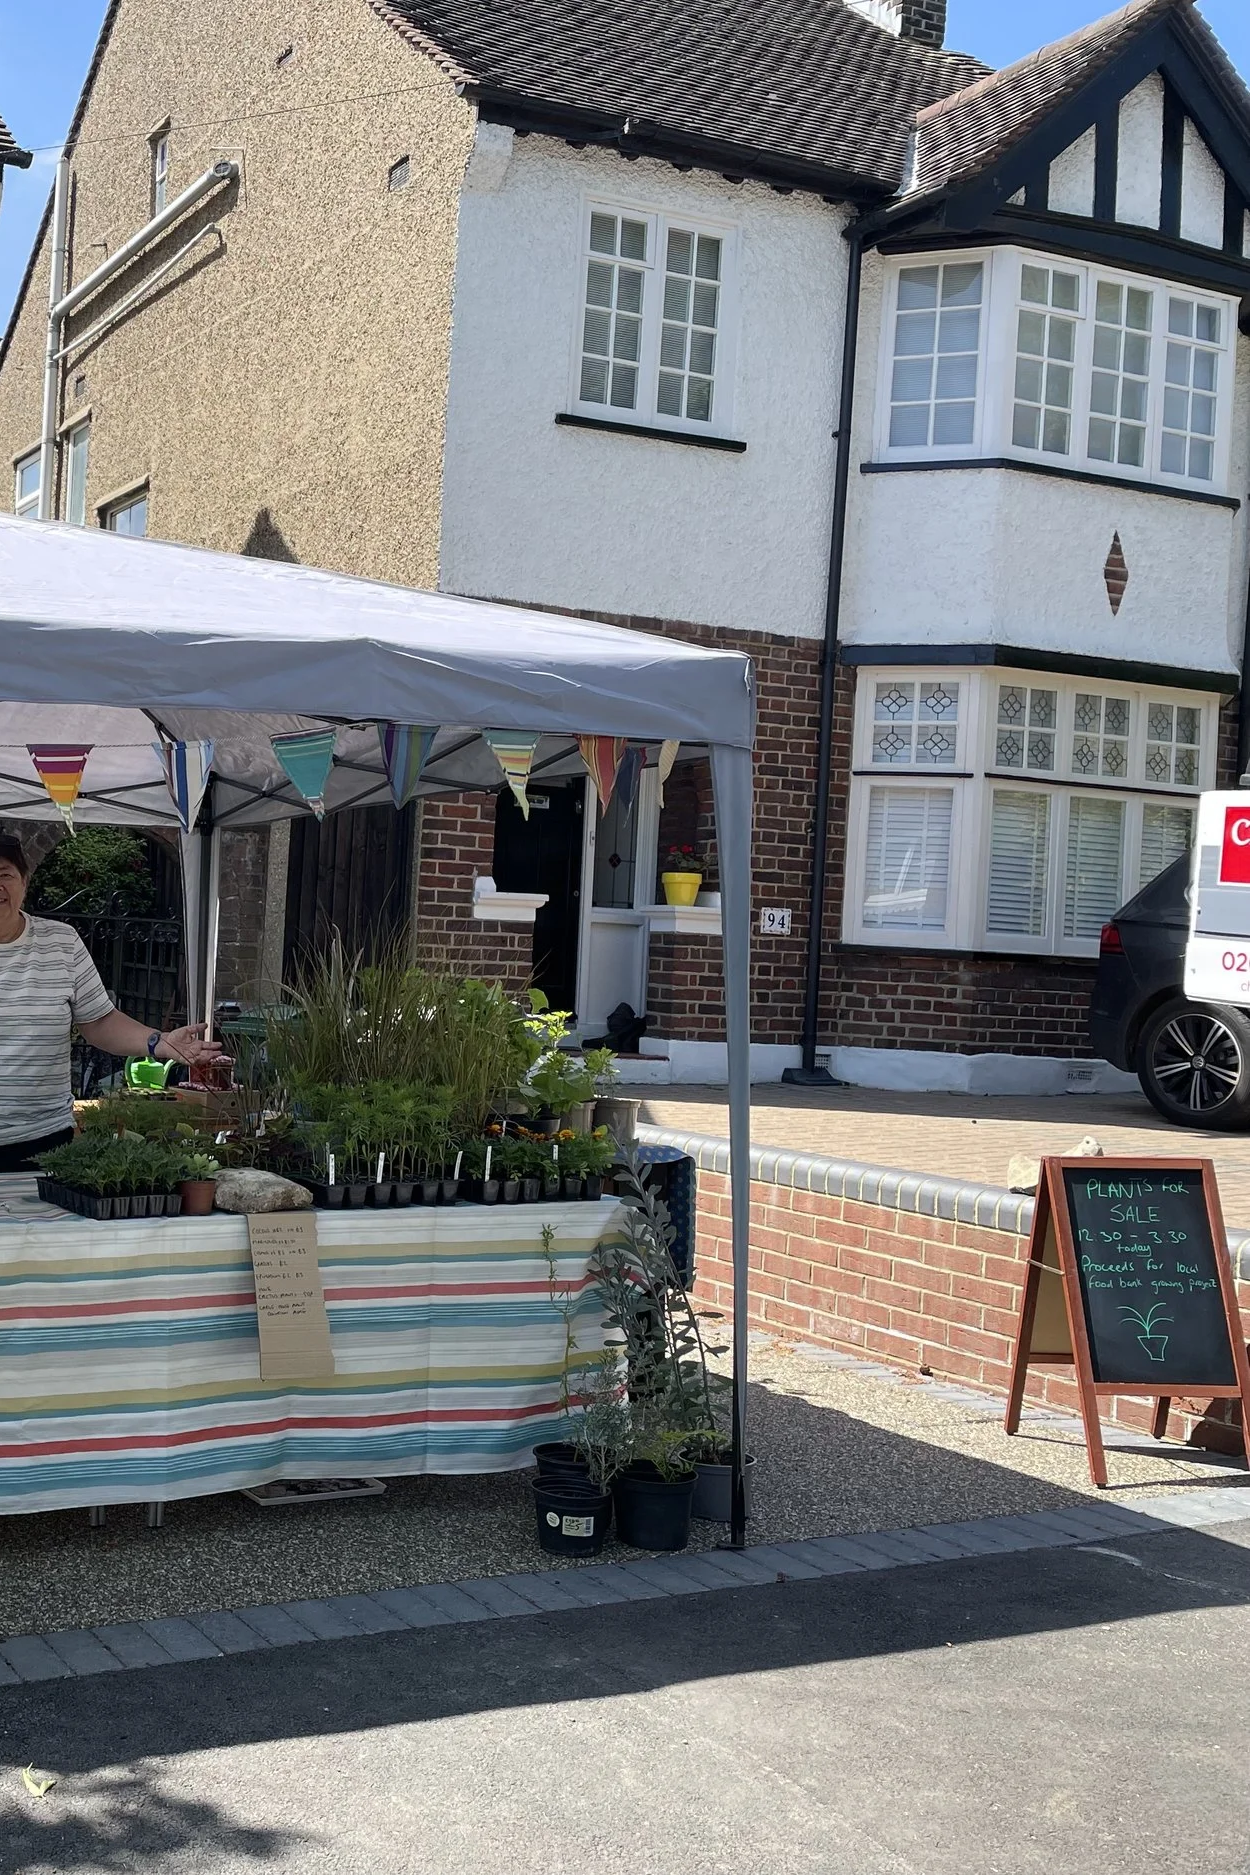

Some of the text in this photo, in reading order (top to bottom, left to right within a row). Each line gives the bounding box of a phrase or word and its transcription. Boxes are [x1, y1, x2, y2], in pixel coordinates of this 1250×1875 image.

[768, 912, 786, 929] 94
[1222, 951, 1250, 972] 02
[1087, 1177, 1190, 1199] PLANTS FOR
[1110, 1203, 1161, 1224] SALE
[1116, 1243, 1152, 1257] today
[1081, 1254, 1199, 1274] Proceeds for local
[1088, 1274, 1114, 1289] food
[1119, 1277, 1143, 1288] bank
[1189, 1278, 1218, 1292] project
